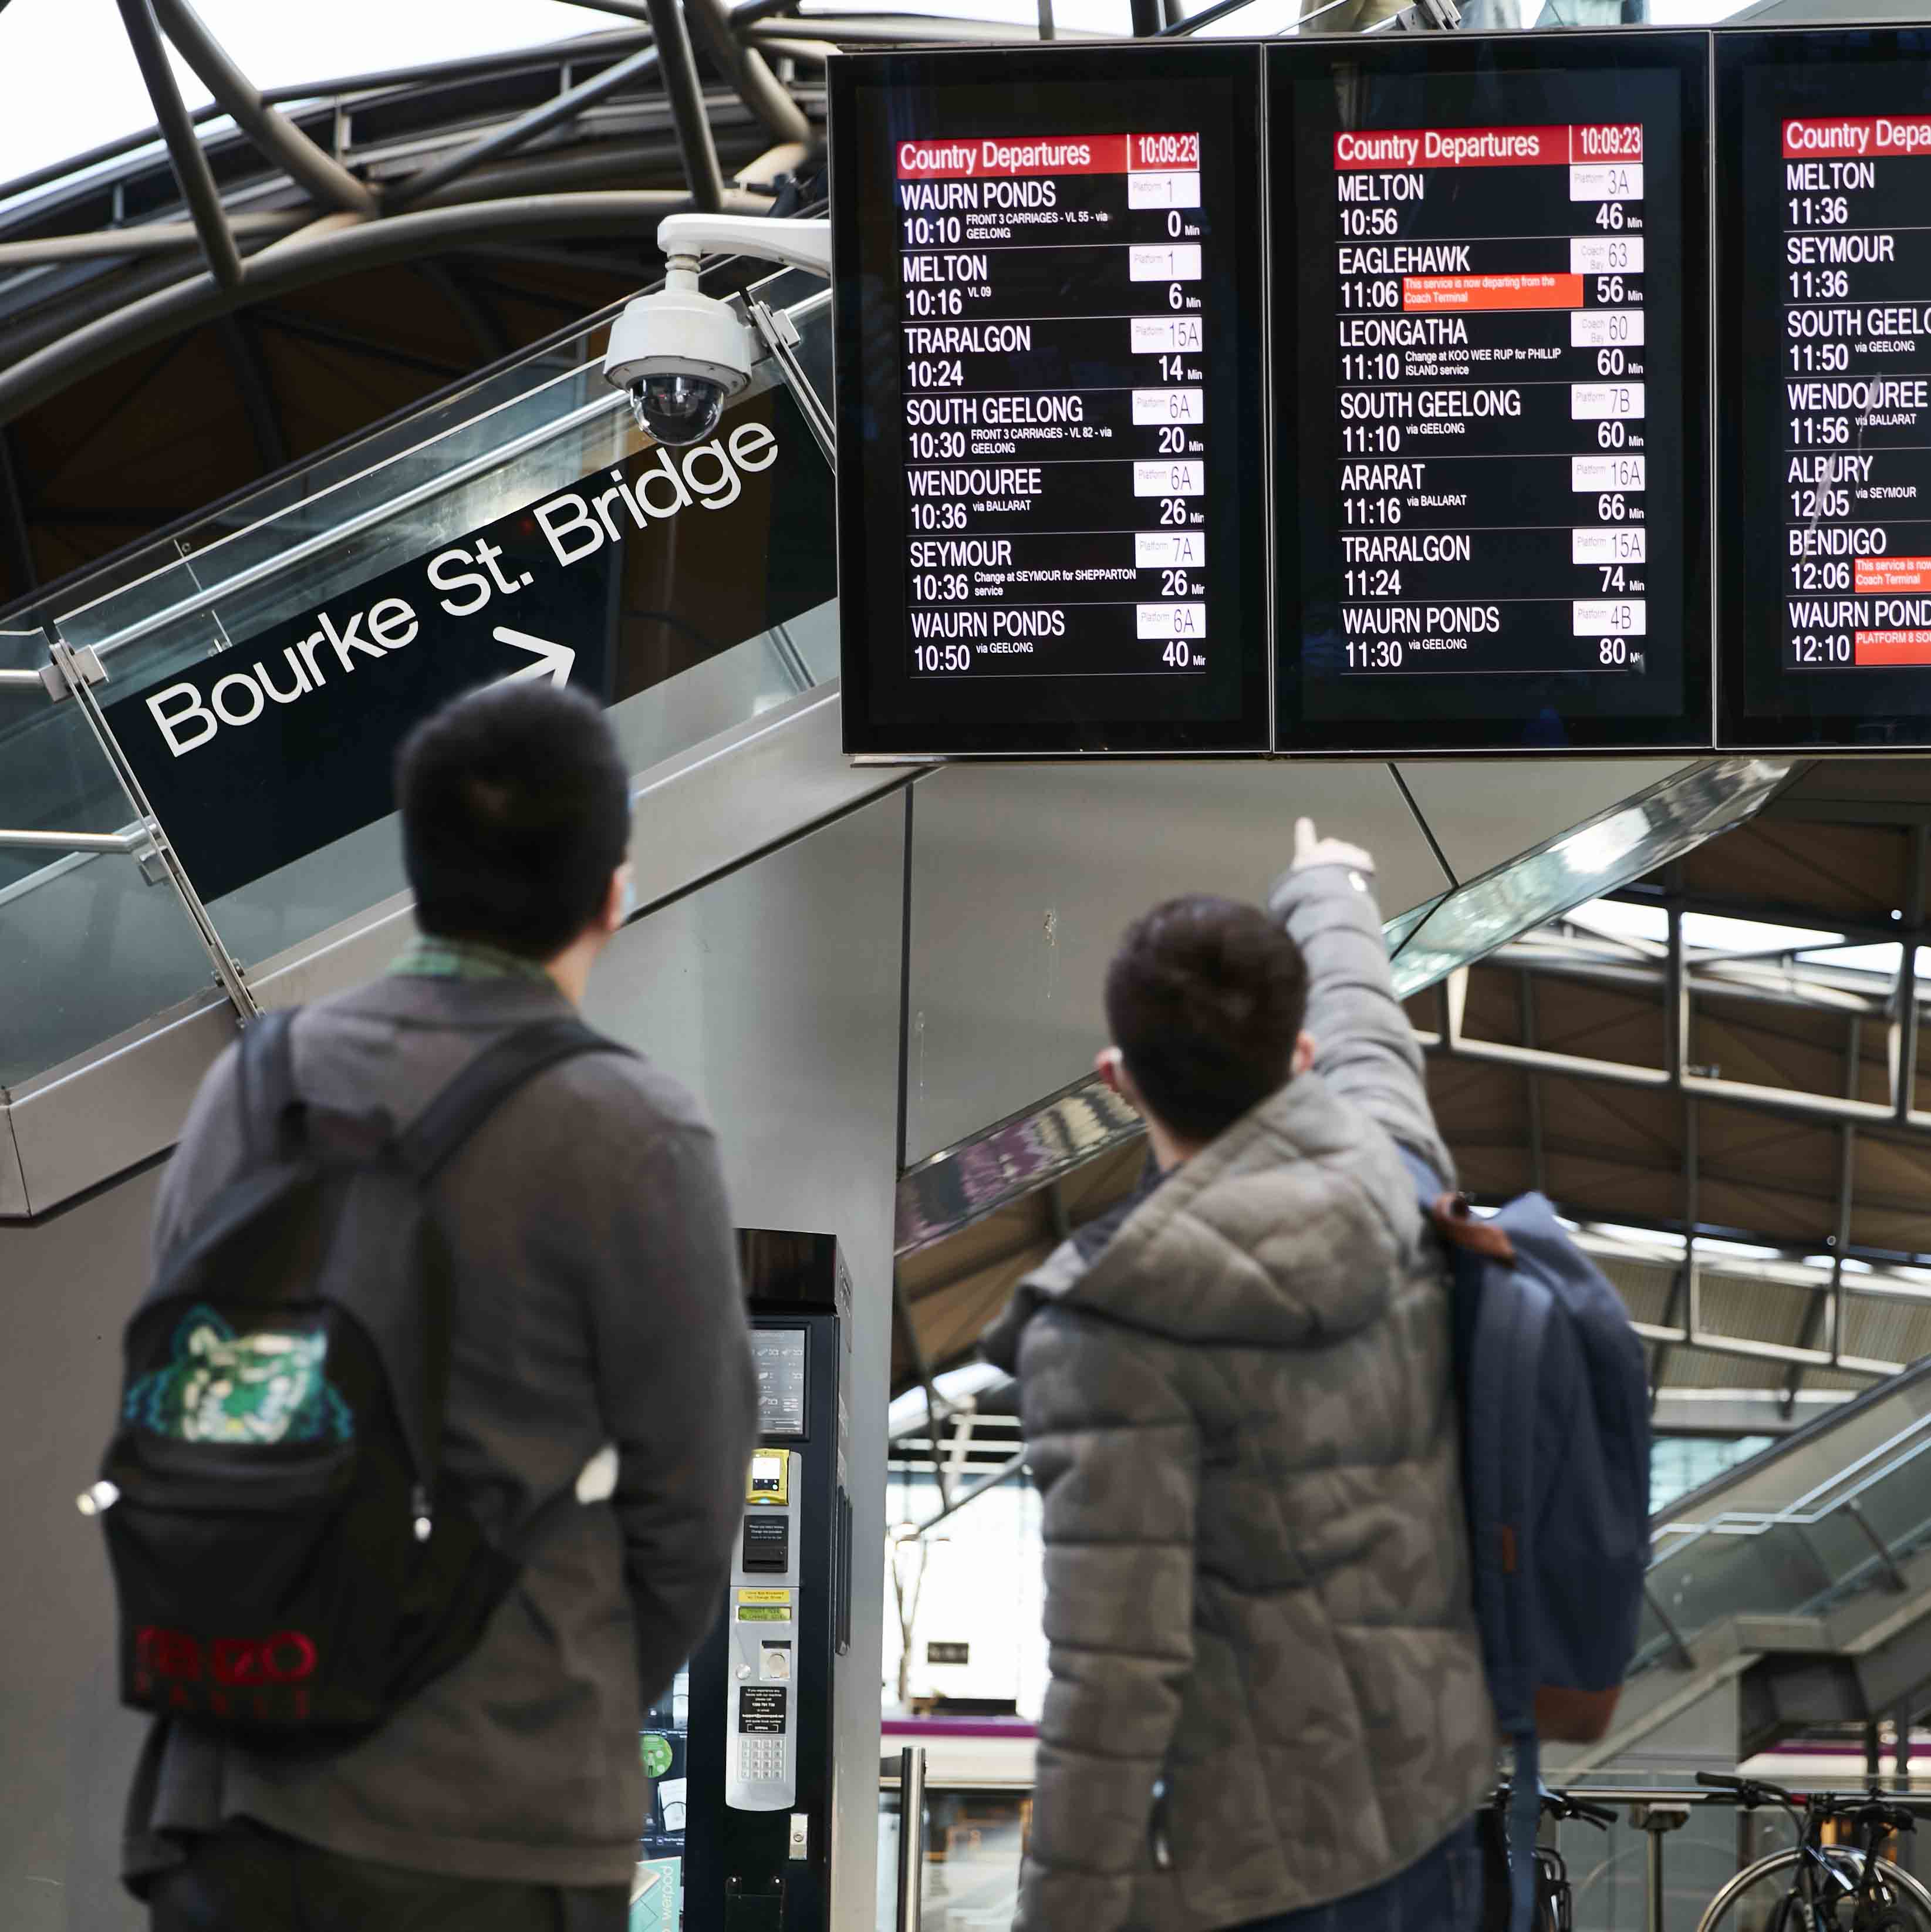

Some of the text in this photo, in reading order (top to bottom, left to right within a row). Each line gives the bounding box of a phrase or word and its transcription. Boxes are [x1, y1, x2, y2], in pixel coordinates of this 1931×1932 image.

[1338, 127, 1640, 166] Country Departures 10:09:23
[1787, 120, 1931, 154] Country Depa
[901, 136, 1197, 175] Country Departures 10:09:23
[1338, 174, 1423, 201] MELTON
[1608, 170, 1629, 194] 3A
[1787, 163, 1874, 190] MELTON
[901, 181, 1056, 210] WAURN PONDS
[967, 211, 1108, 225] FRONT 3 CARRIAGES VL 55 via
[1341, 208, 1397, 235] 10:56
[1596, 203, 1642, 229] 46 Min
[1789, 197, 1848, 224] 11:36
[904, 217, 960, 244] 10:10
[967, 228, 1011, 239] GEELONG
[1168, 211, 1200, 237] 0 Min
[1339, 246, 1470, 274] EAGLEHAWK
[1609, 243, 1627, 268] 63
[1787, 235, 1893, 264] SEYMOUR
[904, 255, 987, 282] MELTON
[968, 286, 991, 297] VL 09
[1169, 283, 1201, 309] 6 Min
[1341, 281, 1398, 308] 11:06
[1404, 278, 1422, 289] This
[1423, 280, 1453, 289] service
[1482, 277, 1519, 290] departing
[1521, 277, 1540, 286] from
[1541, 277, 1554, 286] the
[1597, 276, 1643, 302] 56 Min
[1790, 270, 1848, 298] 11:36
[906, 289, 962, 315] 10:16
[1405, 292, 1467, 304] Coach Terminal
[1169, 323, 1199, 348] 15A
[1341, 319, 1468, 346] LEONGATHA
[1609, 316, 1628, 340] 60
[1788, 310, 1861, 337] SOUTH
[904, 326, 1030, 353] TRARALGON
[1855, 340, 1915, 352] via GEELONG
[1159, 355, 1202, 380] 14 Min
[1342, 353, 1399, 380] 11:10
[1406, 348, 1561, 364] Change KOO WEE RUP for PHILLIP
[1598, 349, 1643, 375] 60 Min
[1790, 343, 1848, 371] 11:50
[908, 360, 963, 387] 10:24
[1406, 365, 1469, 376] ISLAND service
[1170, 395, 1190, 419] 6A
[1341, 390, 1520, 419] SOUTH GEELONG
[1610, 389, 1629, 413] 7B
[1788, 381, 1928, 410] WENDOUREE
[907, 396, 1082, 425] SOUTH GEELONG
[1855, 413, 1916, 427] via BALLARAT
[971, 427, 1112, 440] FRONT 3 CARRIAGES VL 82 via
[1159, 427, 1203, 453] 20 Min
[1343, 426, 1400, 452] 11:10
[1406, 423, 1464, 434] via GEELONG
[1598, 422, 1643, 447] 60 Min
[1791, 417, 1849, 444] 11:56
[910, 432, 965, 458] 10:30
[971, 443, 1015, 454] GEELONG
[908, 468, 1042, 495] WENDOUREE
[1171, 466, 1191, 490] 6A
[1341, 464, 1425, 490] ARARAT
[1611, 461, 1641, 485] 16A
[1788, 456, 1873, 483] ALBURY
[973, 500, 1031, 511] via BALLARAT
[1407, 495, 1467, 506] via BALLARAT
[1856, 487, 1916, 498] via SEYMOUR
[912, 503, 967, 529] 10:36
[1160, 498, 1186, 524] 26
[1344, 498, 1400, 524] 11:16
[1599, 494, 1644, 520] 66 Min
[910, 541, 1011, 567] SEYMOUR
[1173, 538, 1193, 562] 7A
[1342, 535, 1470, 562] TRARALGON
[1612, 534, 1642, 558] 15A
[1790, 528, 1886, 556] BENDIGO
[913, 574, 968, 600] 10:36
[974, 569, 1136, 584] Change SEYMOUR for SHEPPARTON
[1162, 570, 1187, 595] 26
[1345, 569, 1401, 595] 11:24
[1599, 566, 1645, 592] 74 Min
[1792, 562, 1849, 589] 12:06
[145, 421, 779, 758] Bourke St. Bridge
[975, 586, 1003, 596] service
[912, 611, 1065, 638] WAURN PONDS
[1174, 609, 1194, 633] 6A
[1343, 606, 1499, 633] WAURN PONDS
[1611, 605, 1631, 629] 4B
[1789, 601, 1868, 628] WAURN
[976, 642, 1033, 653] via GEELONG
[1409, 639, 1467, 649] via GEELONG
[1792, 635, 1849, 661] 12:10
[1856, 632, 1906, 643] PLATFORM
[915, 645, 970, 670] 10:50
[1163, 641, 1188, 666] 40
[1346, 641, 1402, 667] 11:30
[1600, 638, 1625, 664] 80
